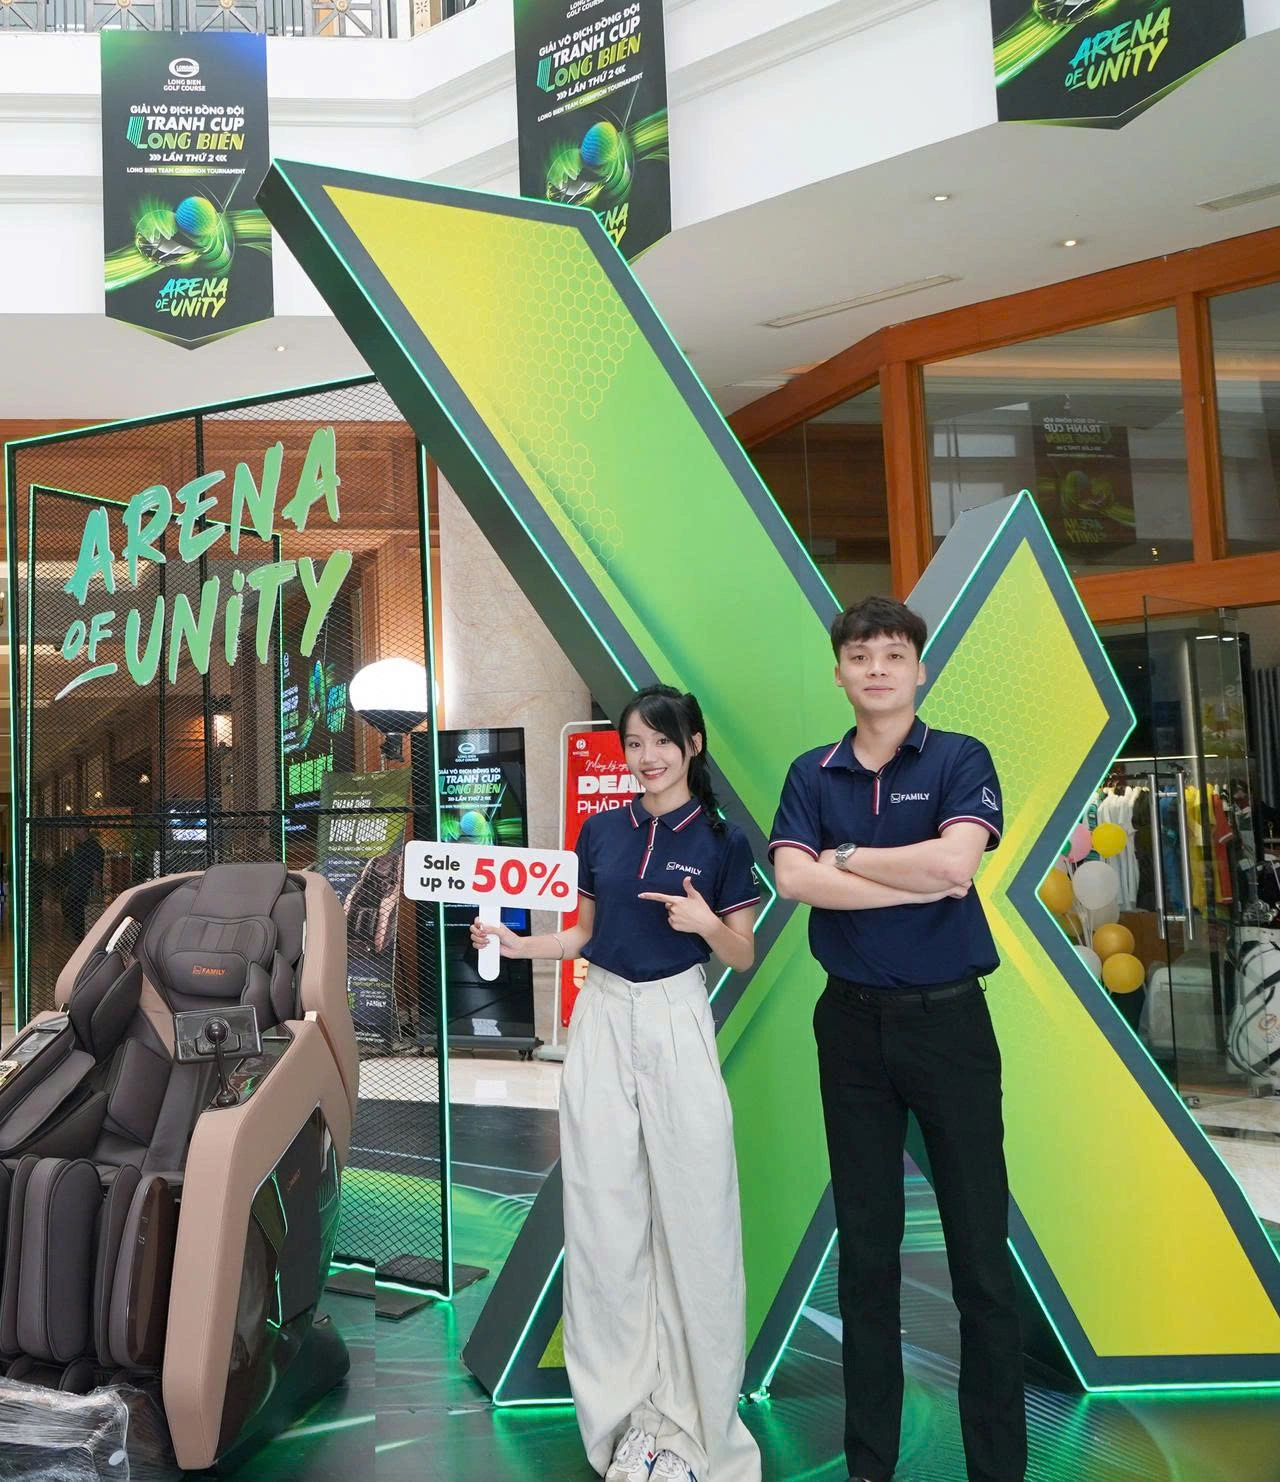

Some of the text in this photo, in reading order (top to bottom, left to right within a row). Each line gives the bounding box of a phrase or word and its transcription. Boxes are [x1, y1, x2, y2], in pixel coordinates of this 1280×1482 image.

[538, 42, 557, 57] GIẢI
[558, 35, 572, 48] VÔ
[594, 14, 621, 32] ĐỒNG
[623, 3, 640, 19] ĐỘI
[1068, 7, 1170, 68] ARENA
[553, 15, 641, 68] TRANH CUP
[536, 32, 642, 93] LONG BIÊN
[607, 70, 614, 79] 2
[1064, 68, 1085, 89] OF
[130, 103, 151, 114] GIẢI
[153, 104, 168, 114] VÔ
[195, 103, 224, 115] ĐỒNG
[226, 104, 244, 117] ĐỘI
[126, 117, 245, 150] LONG BIÊN
[146, 116, 245, 132] TRANH CUP
[159, 277, 229, 298] ARENA
[155, 298, 169, 309] OF
[63, 425, 342, 606] ARENA
[60, 610, 117, 663] OF
[446, 774, 501, 784] TRANH CUP
[901, 792, 930, 801] FAMILY
[423, 854, 461, 871] Sale
[675, 863, 702, 875] FAMILY
[420, 876, 465, 892] up to
[472, 857, 569, 898] 50%
[201, 966, 225, 976] FAMILY
